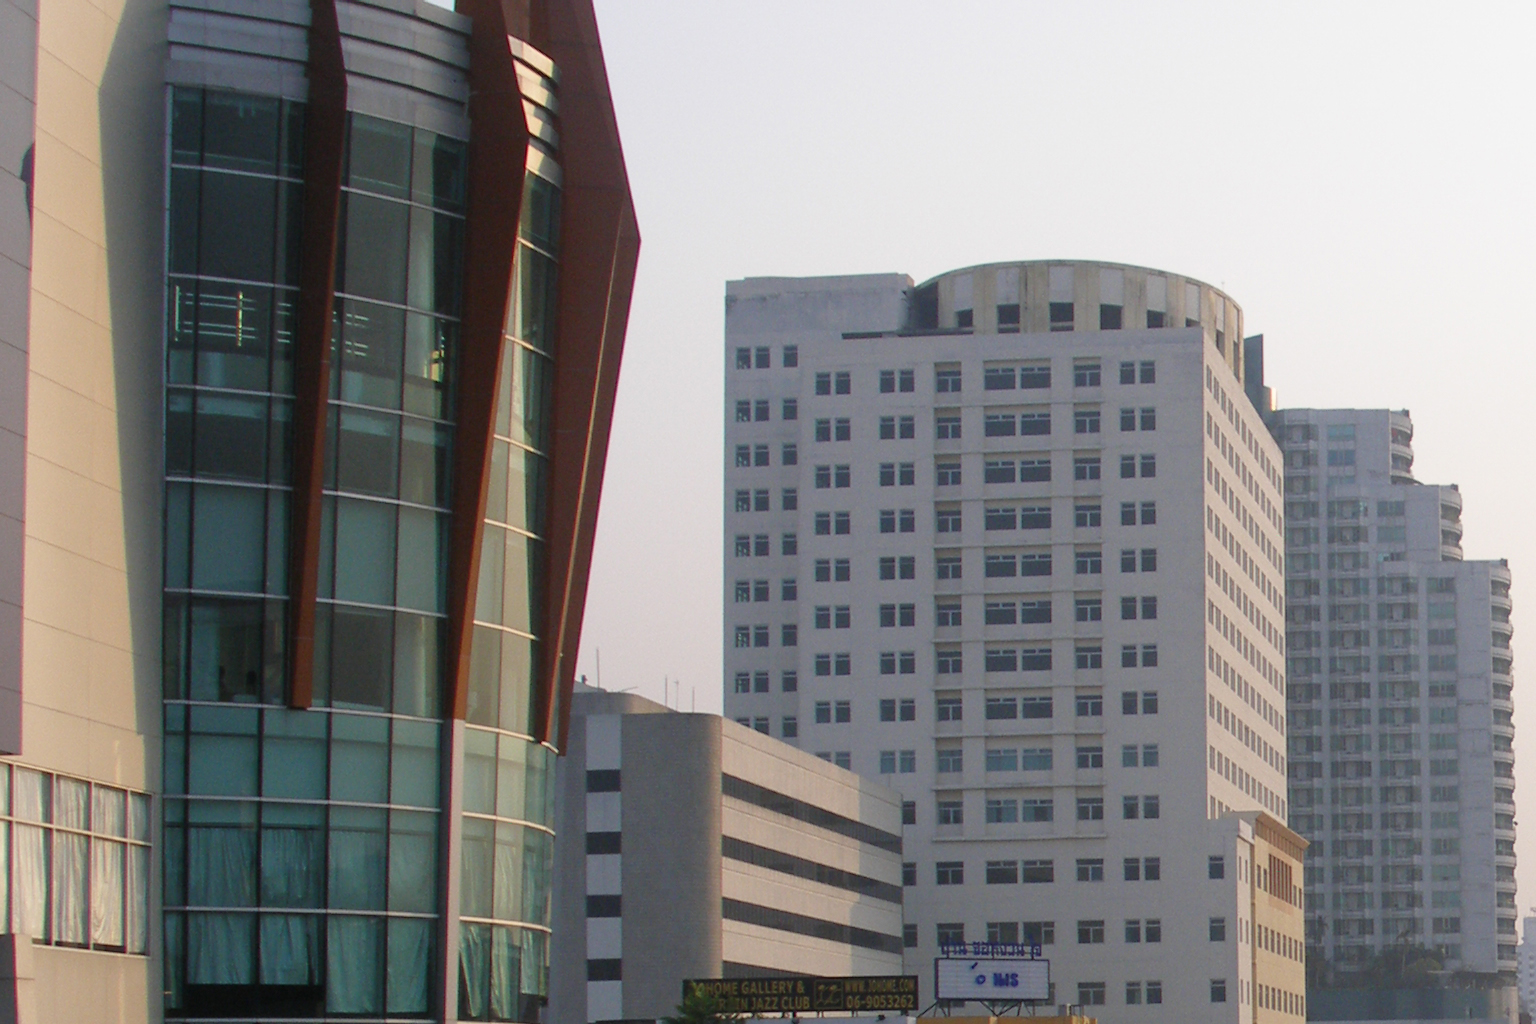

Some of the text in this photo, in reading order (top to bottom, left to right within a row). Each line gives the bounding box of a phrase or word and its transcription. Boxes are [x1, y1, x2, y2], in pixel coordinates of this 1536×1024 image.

[740, 981, 793, 995] GALLERY
[796, 980, 805, 993] &
[751, 996, 778, 1010] JAZZ
[781, 995, 811, 1009] CLUB
[846, 995, 914, 1009] 06-9053262
